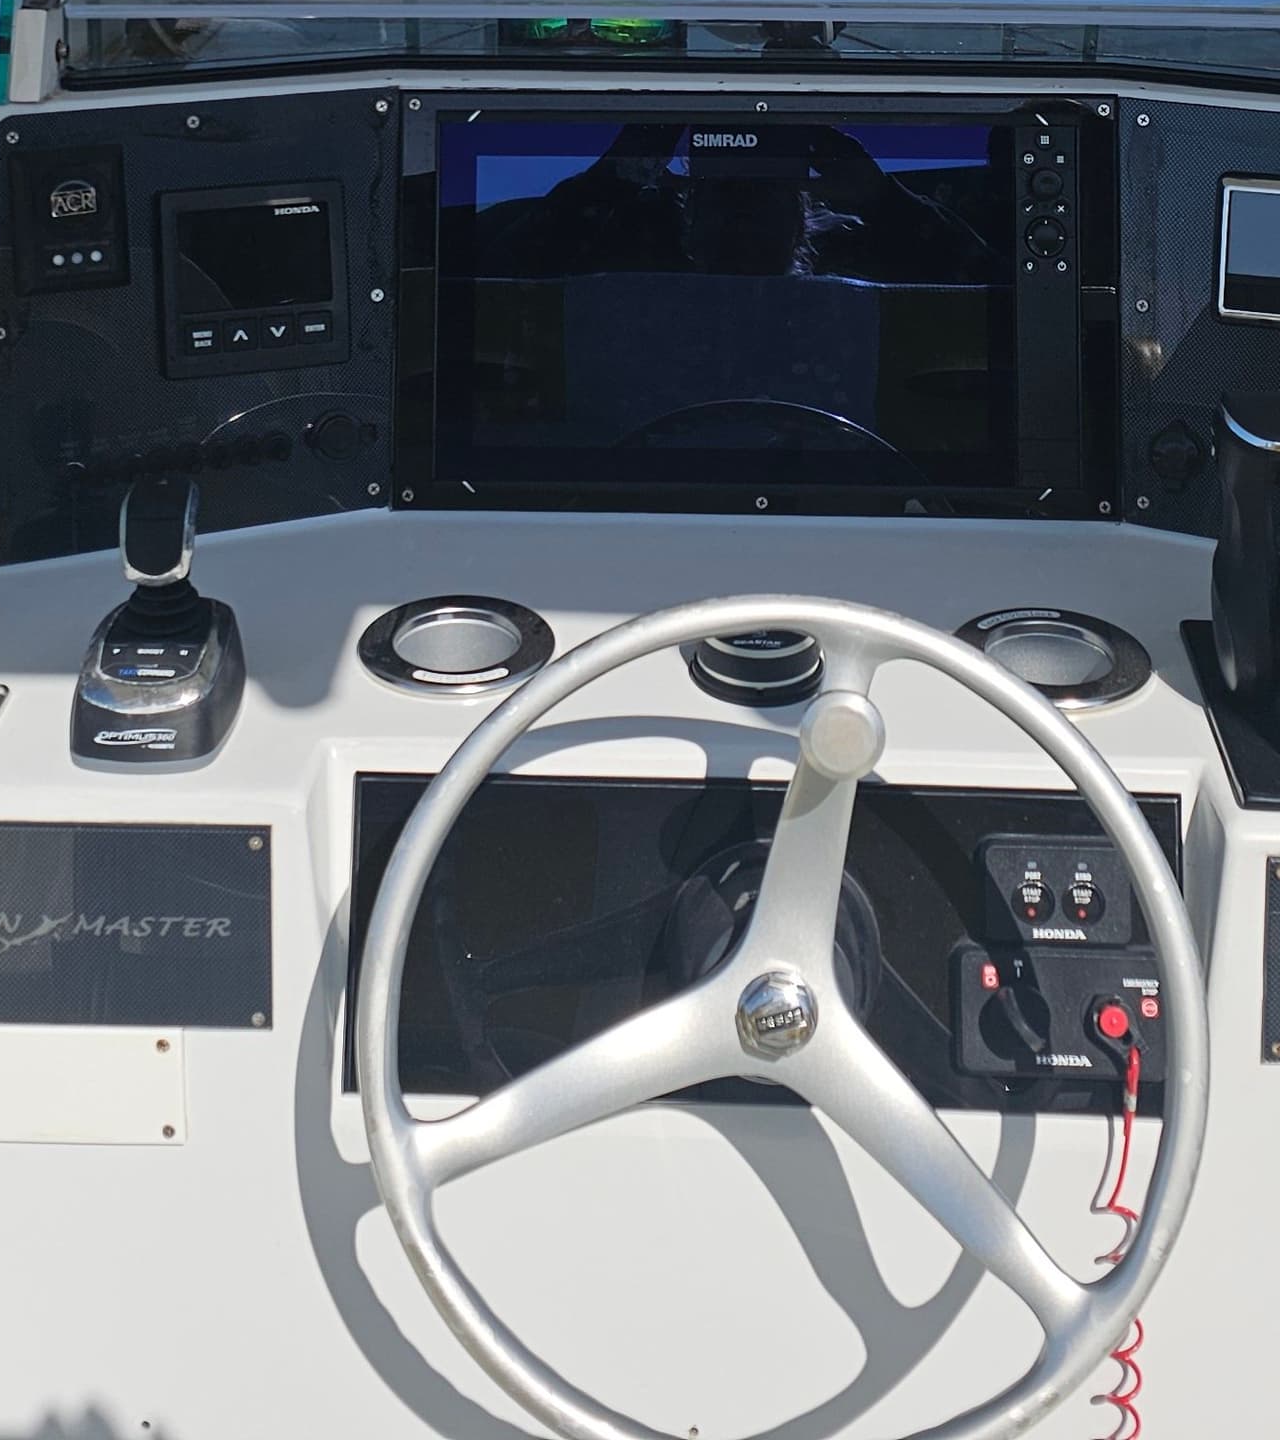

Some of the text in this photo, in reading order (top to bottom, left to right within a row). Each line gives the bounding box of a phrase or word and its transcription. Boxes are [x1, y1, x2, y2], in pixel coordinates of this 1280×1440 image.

[692, 133, 759, 148] SIMRAD
[51, 190, 96, 214] ACR
[273, 204, 321, 216] HONDA
[70, 913, 233, 938] MASTER
[1032, 927, 1088, 941] HONDA
[1035, 1053, 1094, 1068] HONDA
